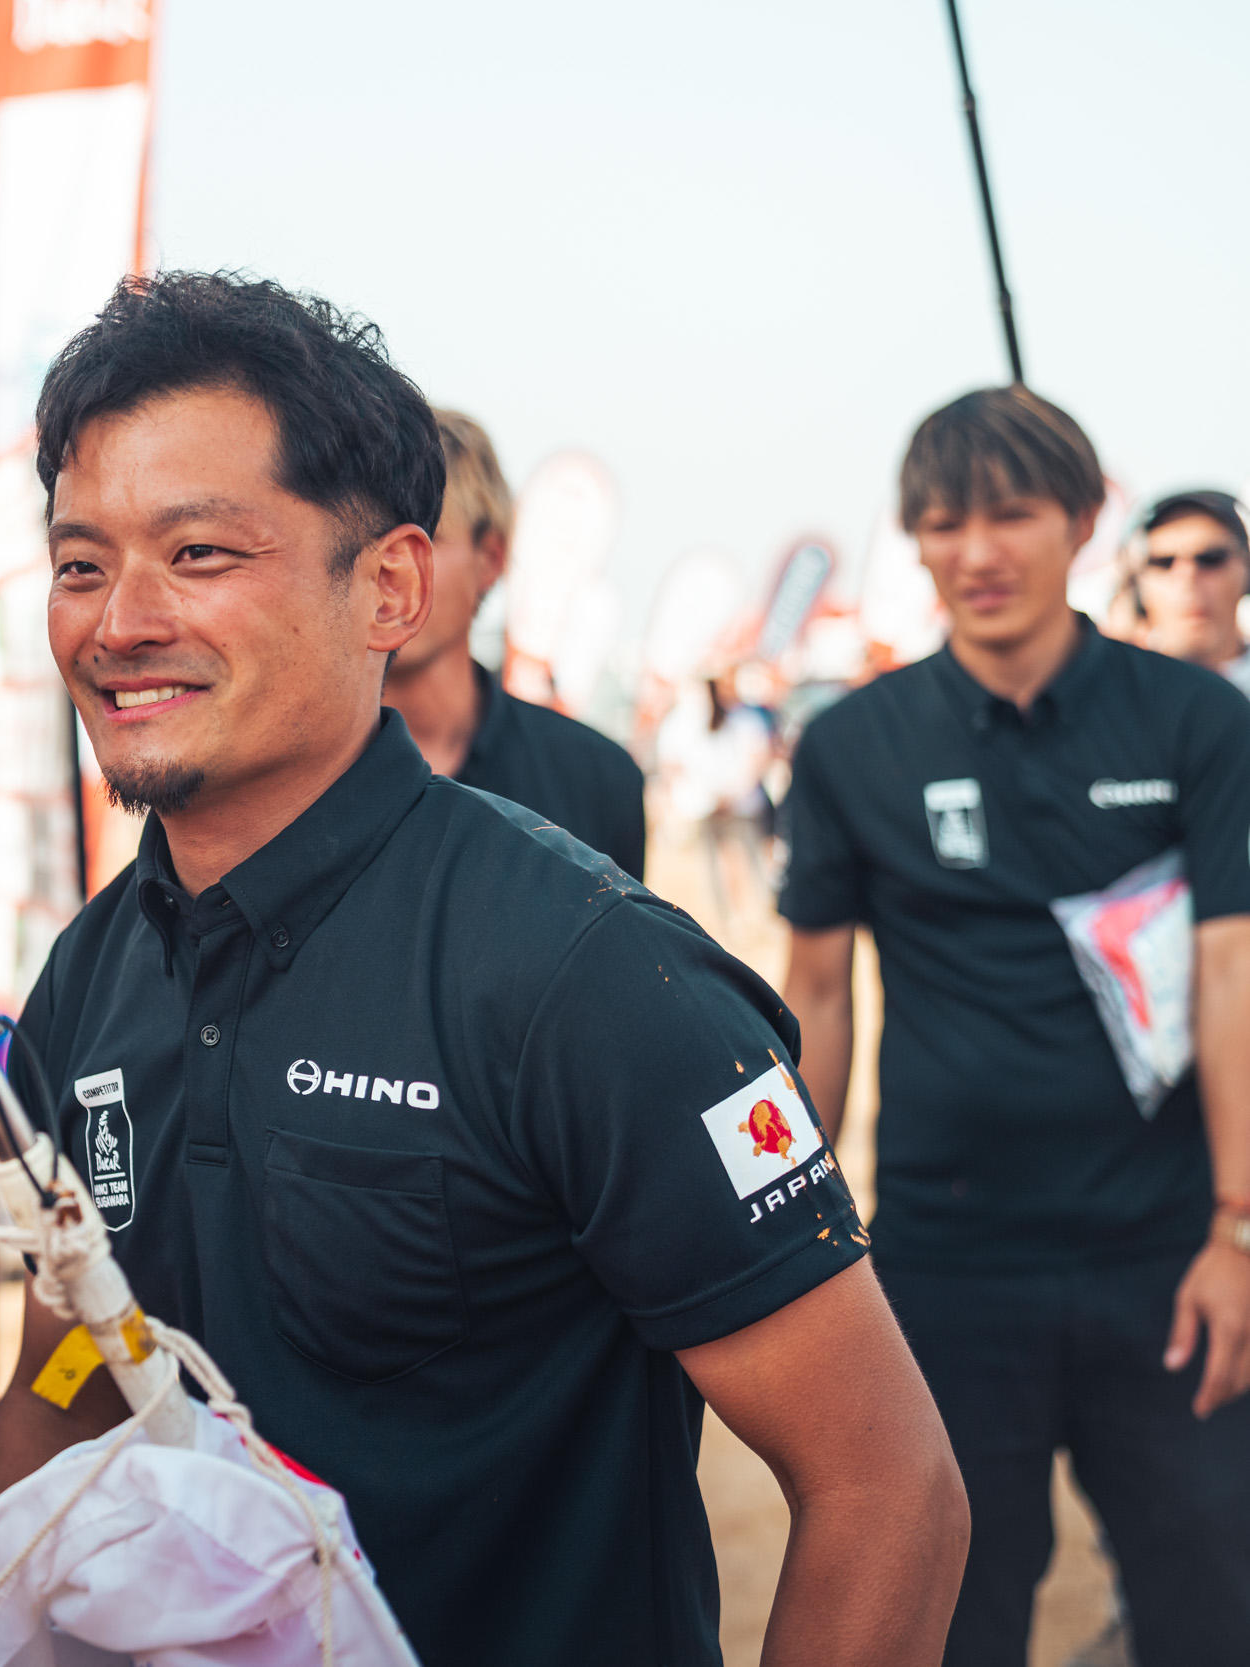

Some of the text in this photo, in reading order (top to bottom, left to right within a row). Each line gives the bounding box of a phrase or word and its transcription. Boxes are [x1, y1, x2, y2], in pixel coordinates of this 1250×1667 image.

[82, 1081, 119, 1099] COMPETITOR
[322, 1070, 440, 1110] HINO
[95, 1150, 121, 1172] DAKAR
[109, 1180, 128, 1194] TEAM
[750, 1155, 833, 1224] JAPAN
